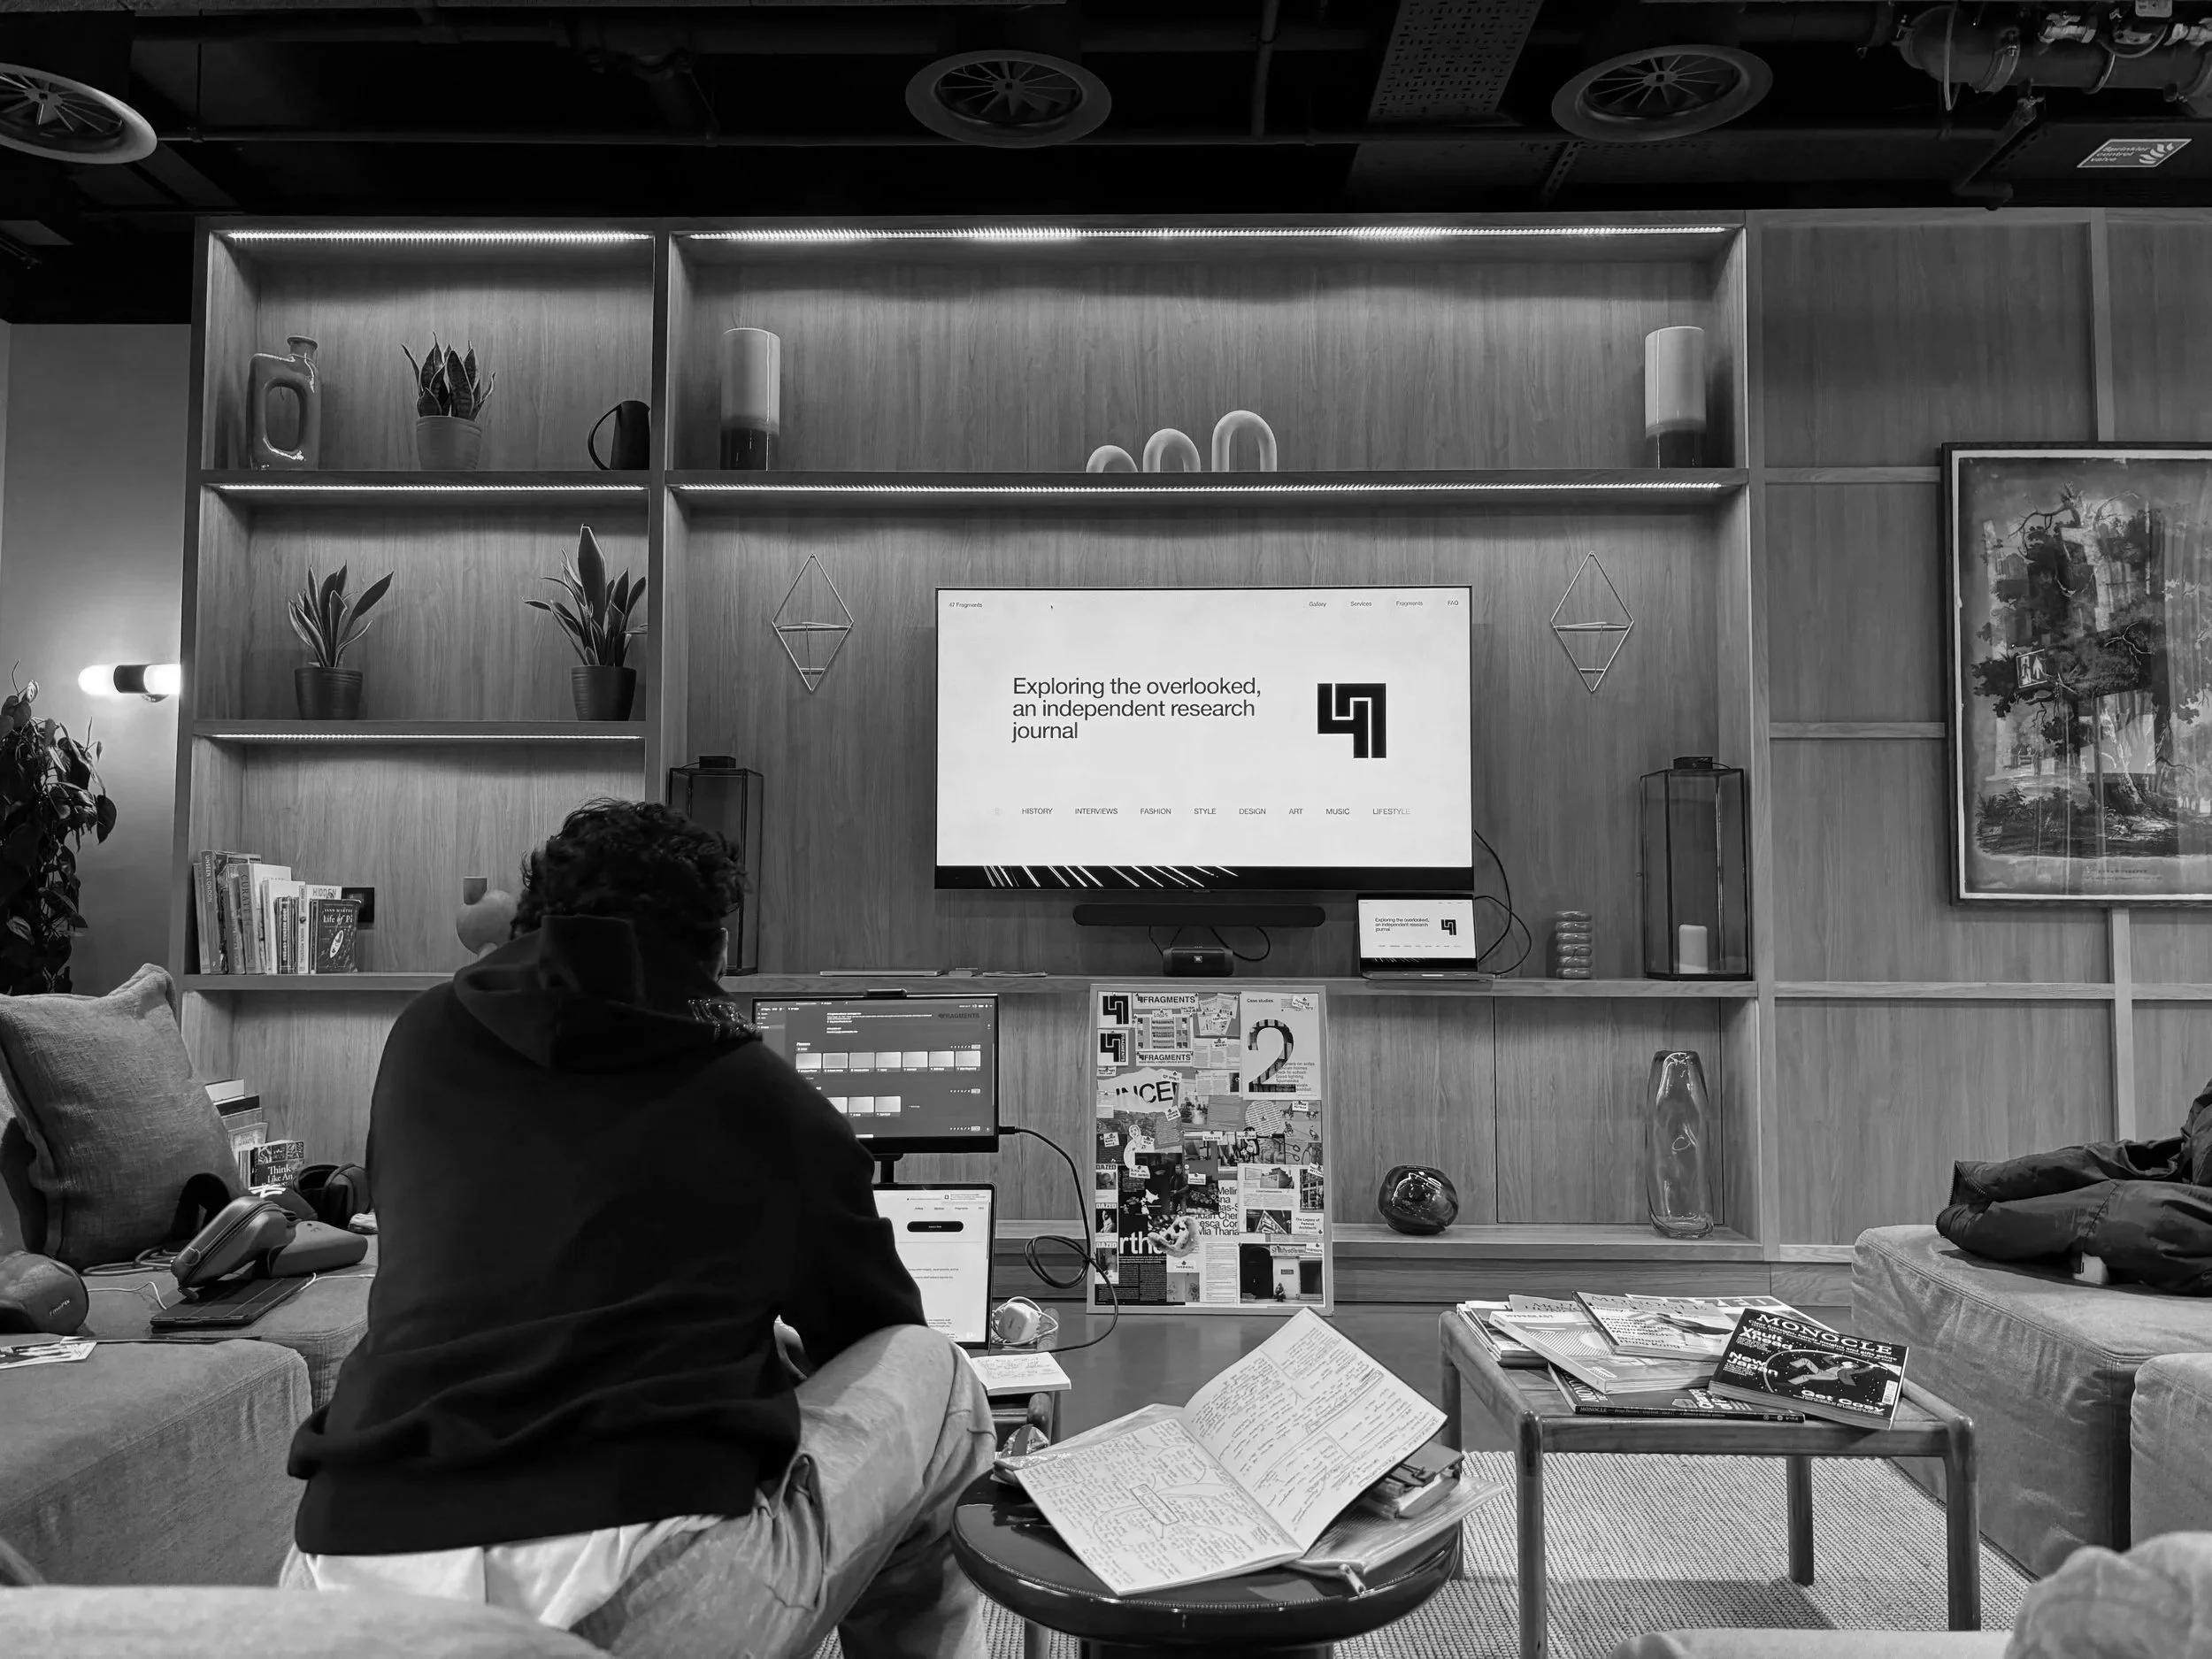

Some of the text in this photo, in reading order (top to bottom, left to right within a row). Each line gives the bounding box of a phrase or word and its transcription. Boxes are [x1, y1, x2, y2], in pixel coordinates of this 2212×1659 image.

[1013, 677, 1262, 699] Exploring the overlooked,
[1012, 699, 1256, 720] an independent research
[1011, 721, 1079, 743] journal
[240, 874, 251, 914] CURATE
[312, 887, 337, 899] HIDDEN
[323, 912, 353, 926] Life of Pi
[1248, 1018, 1296, 1093] 2
[267, 1164, 292, 1175] Think
[1739, 1332, 1793, 1350] Ahead
[1743, 1325, 1784, 1342] Vault
[1757, 1314, 1893, 1356] MONOCLE
[1727, 1358, 1778, 1378] Japan
[1801, 1389, 1833, 1402] Get
[1838, 1398, 1885, 1412] Cosy
